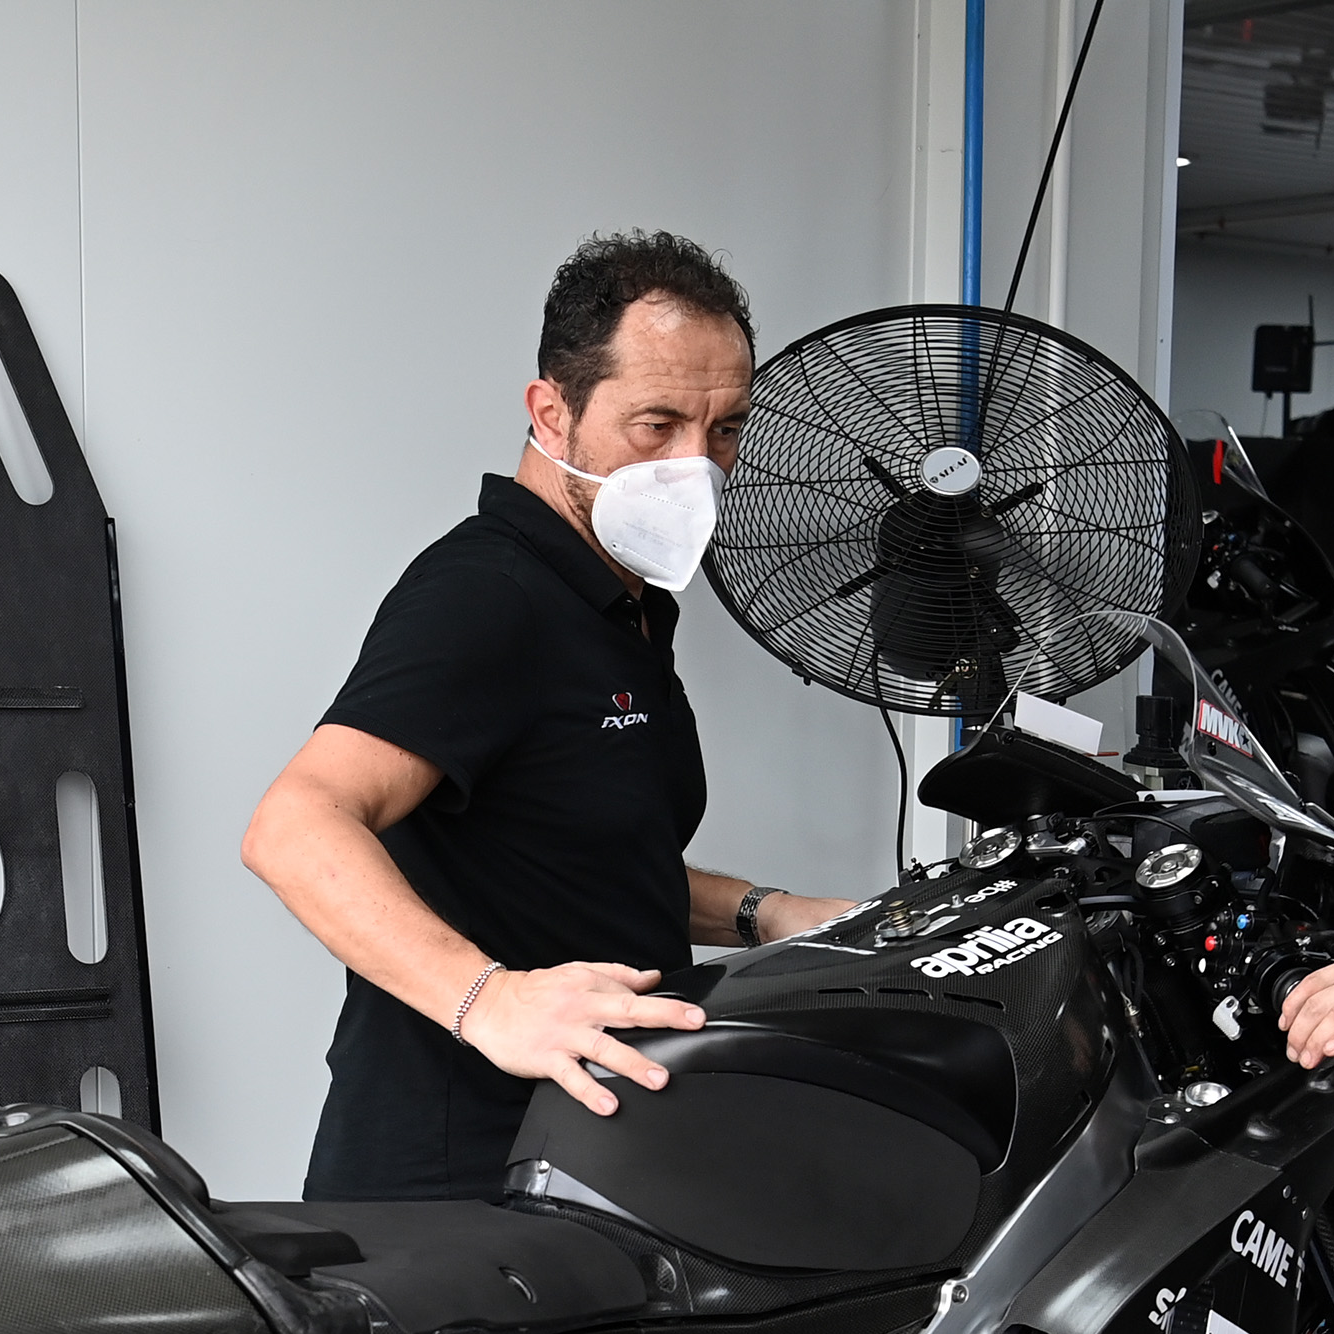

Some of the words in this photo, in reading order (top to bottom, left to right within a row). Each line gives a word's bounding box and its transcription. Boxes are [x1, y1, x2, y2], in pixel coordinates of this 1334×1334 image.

[600, 712, 649, 730] IXON
[1200, 702, 1241, 749] MVK
[910, 917, 1052, 979] aprilia
[974, 931, 1064, 976] RACING
[1231, 1210, 1295, 1288] CAME
